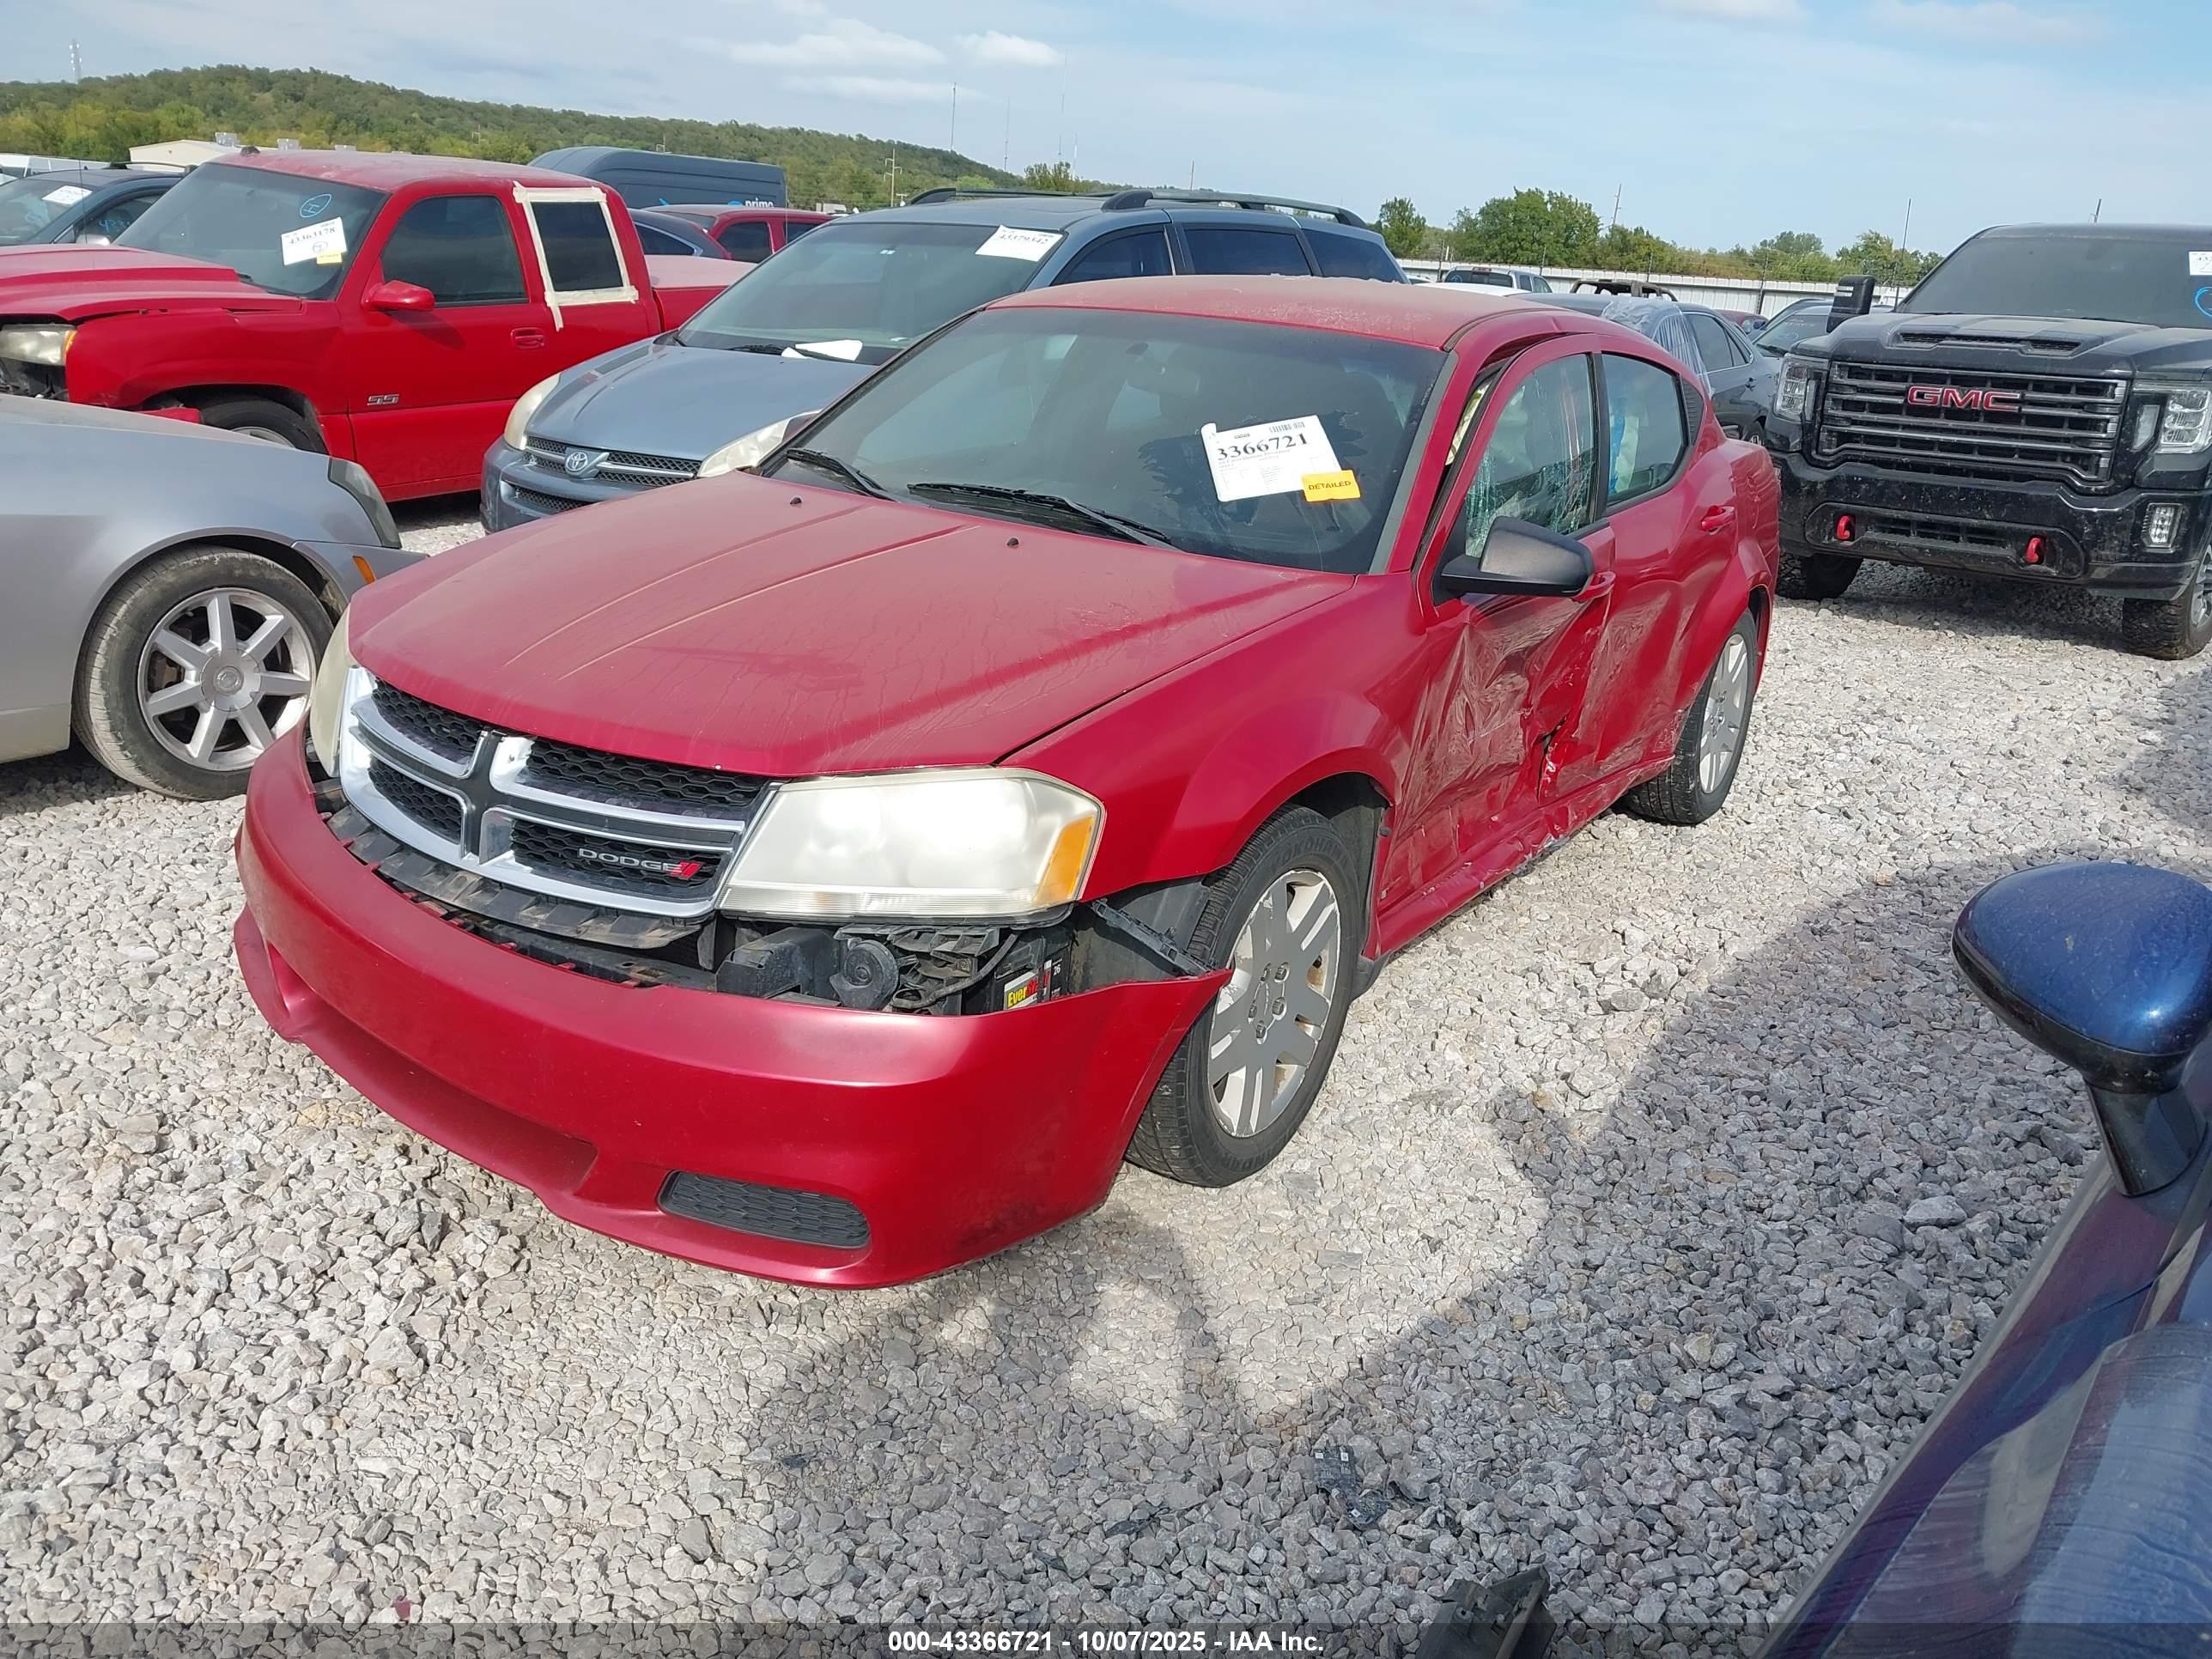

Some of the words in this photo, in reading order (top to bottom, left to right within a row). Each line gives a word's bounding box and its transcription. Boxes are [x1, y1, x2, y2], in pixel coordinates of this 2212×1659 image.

[367, 393, 399, 406] SS
[1907, 386, 2021, 412] GMC
[1218, 433, 1308, 460] 3366721
[1308, 480, 1352, 491] DETAILED
[579, 848, 683, 873] DODGE
